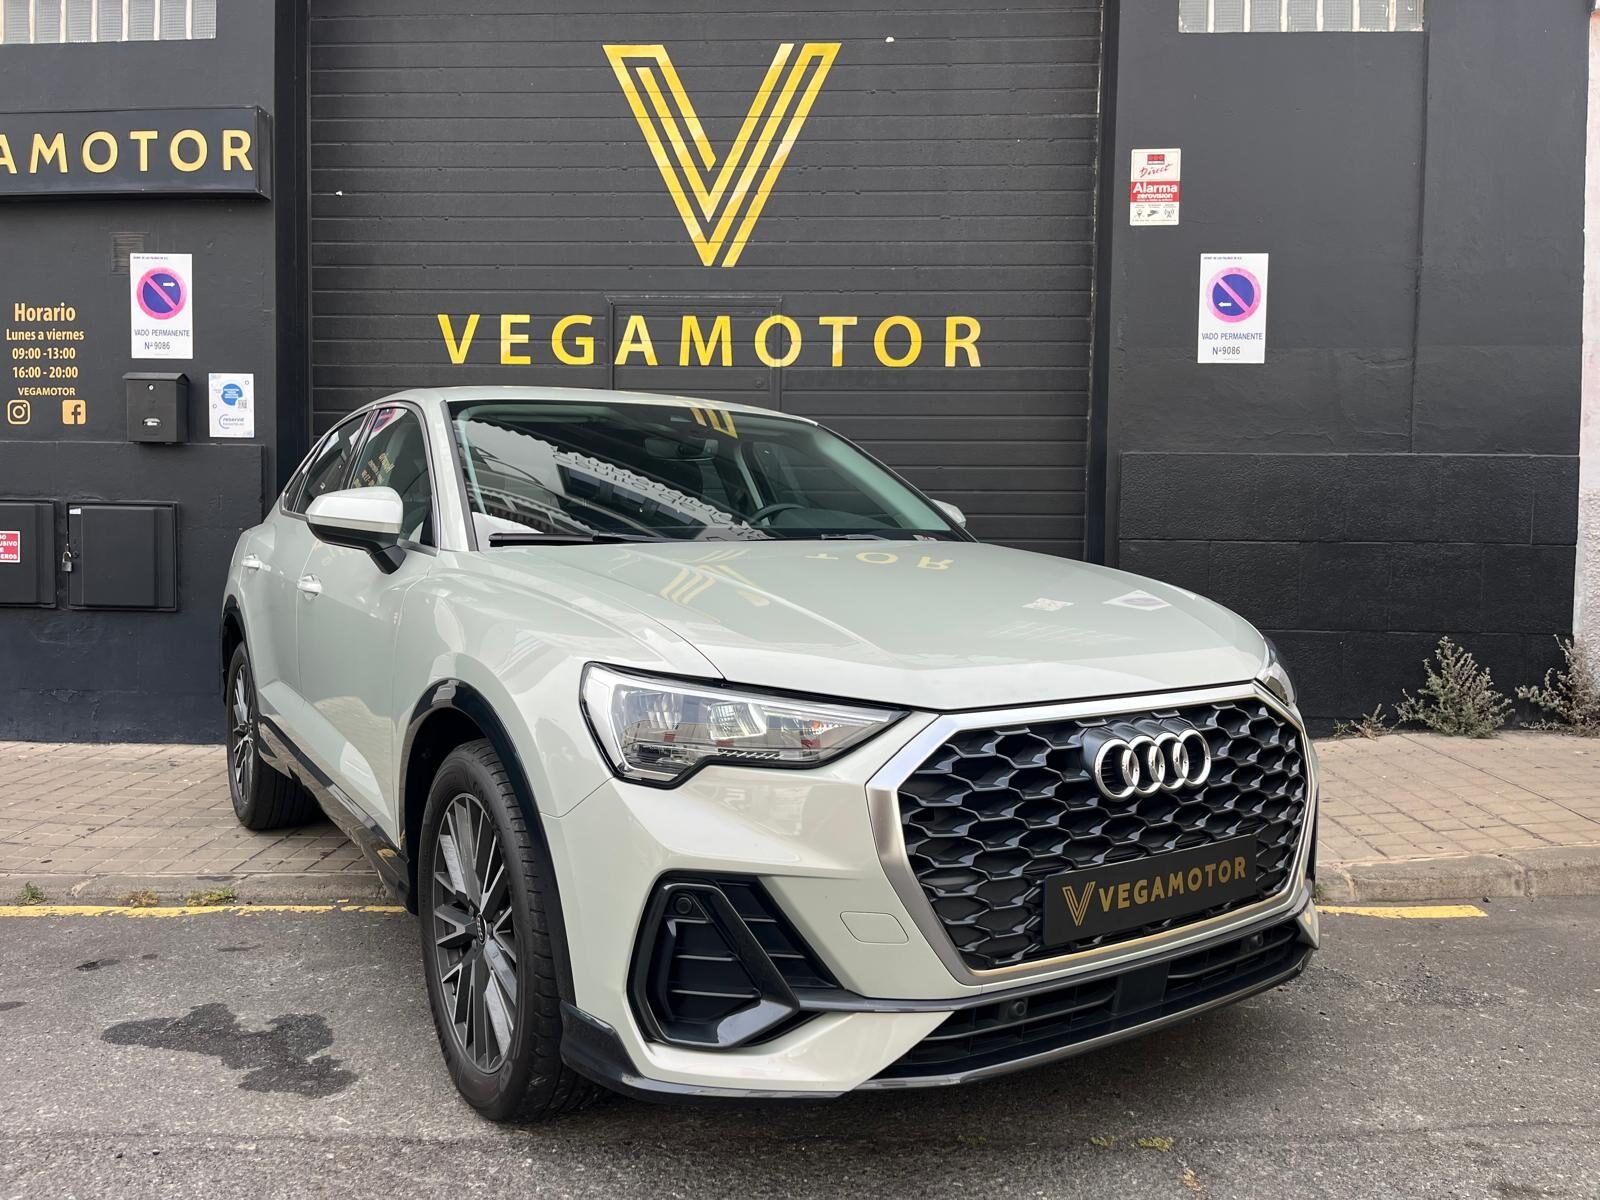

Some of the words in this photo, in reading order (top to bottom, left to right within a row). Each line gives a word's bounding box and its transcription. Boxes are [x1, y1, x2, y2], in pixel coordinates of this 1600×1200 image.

[0, 129, 253, 174] AMOTOR
[1133, 182, 1177, 193] Alarma
[14, 302, 76, 322] Horario
[6, 328, 36, 341] Lunes
[38, 332, 44, 341] a
[46, 328, 85, 341] viernes
[134, 329, 150, 337] VADO
[151, 329, 190, 337] PERMANENTE
[437, 314, 982, 368] VEGAMOTOR
[12, 347, 41, 360] 09:00
[12, 366, 41, 379] 16:00
[49, 366, 79, 379] 20:00
[18, 387, 76, 396] VEGAMOTOR
[1098, 856, 1246, 912] VEGAMOTOR
